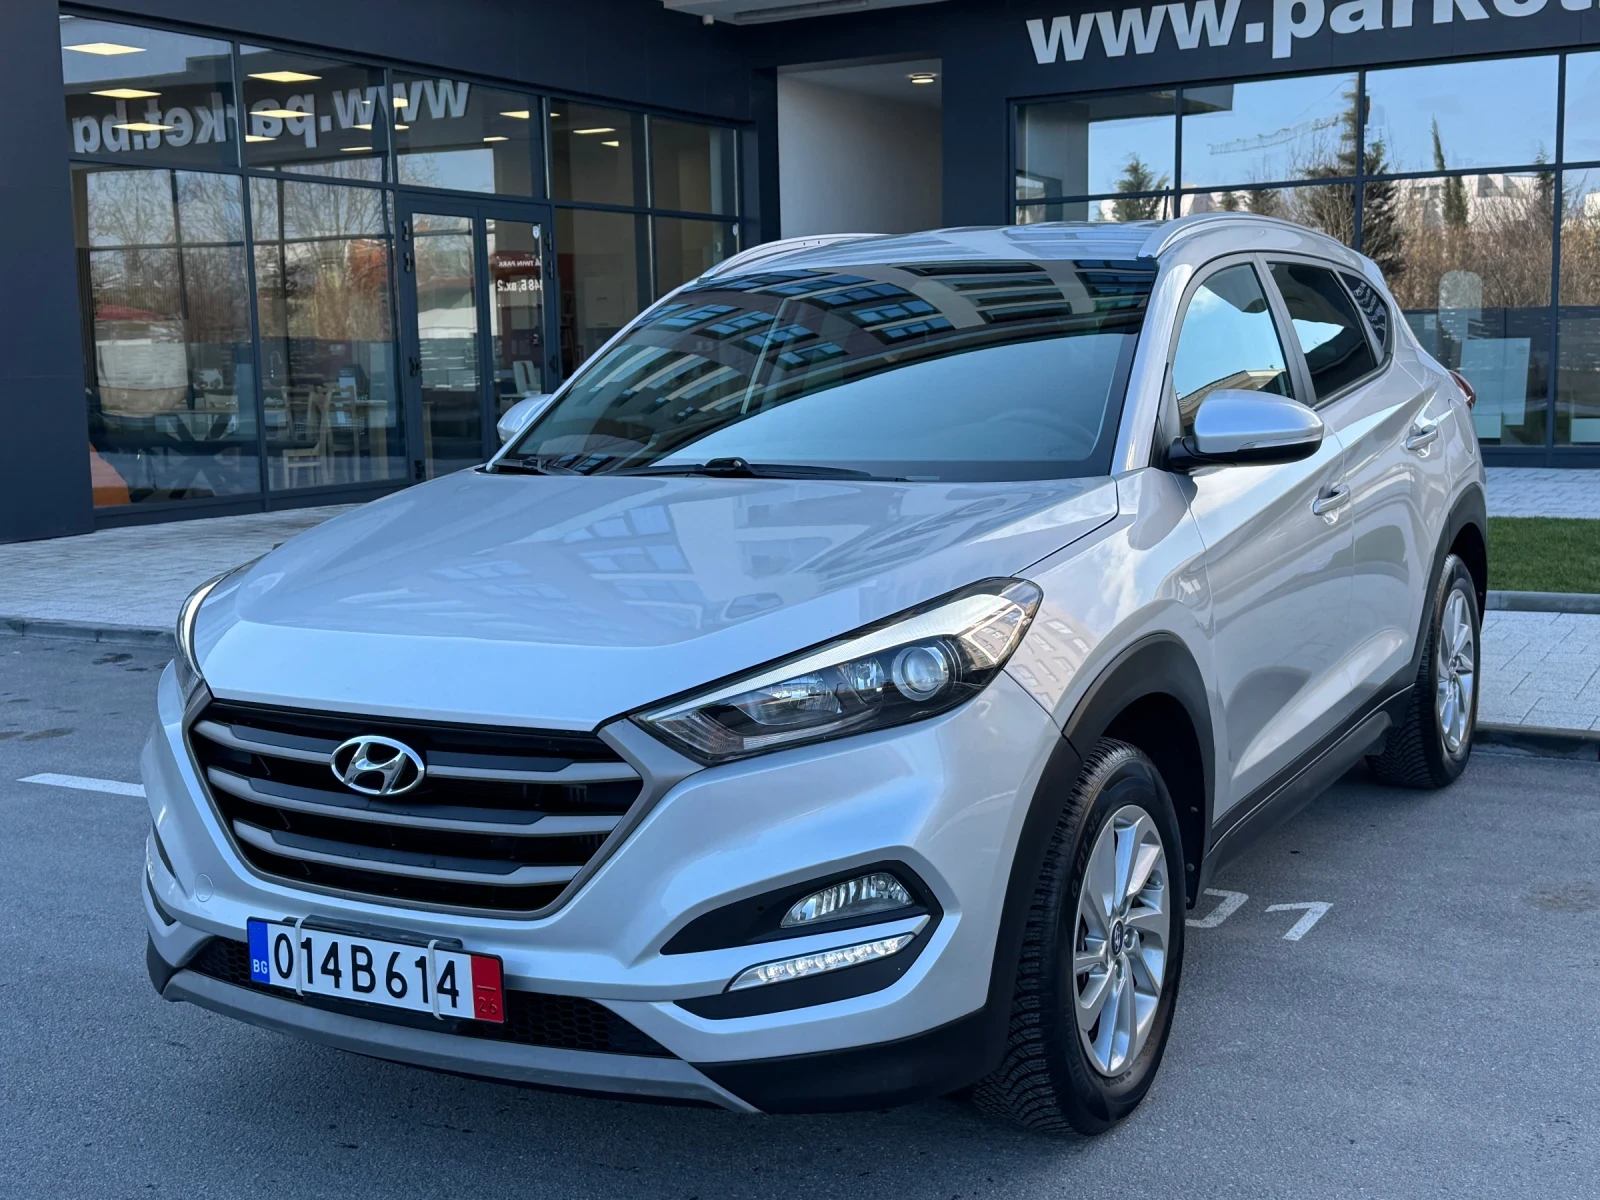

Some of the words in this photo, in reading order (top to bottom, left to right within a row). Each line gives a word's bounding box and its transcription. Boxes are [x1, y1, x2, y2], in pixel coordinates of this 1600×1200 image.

[1026, 0, 1595, 64] www.par
[253, 958, 268, 975] BG
[274, 932, 459, 1009] 014B614
[478, 996, 498, 1014] 26
